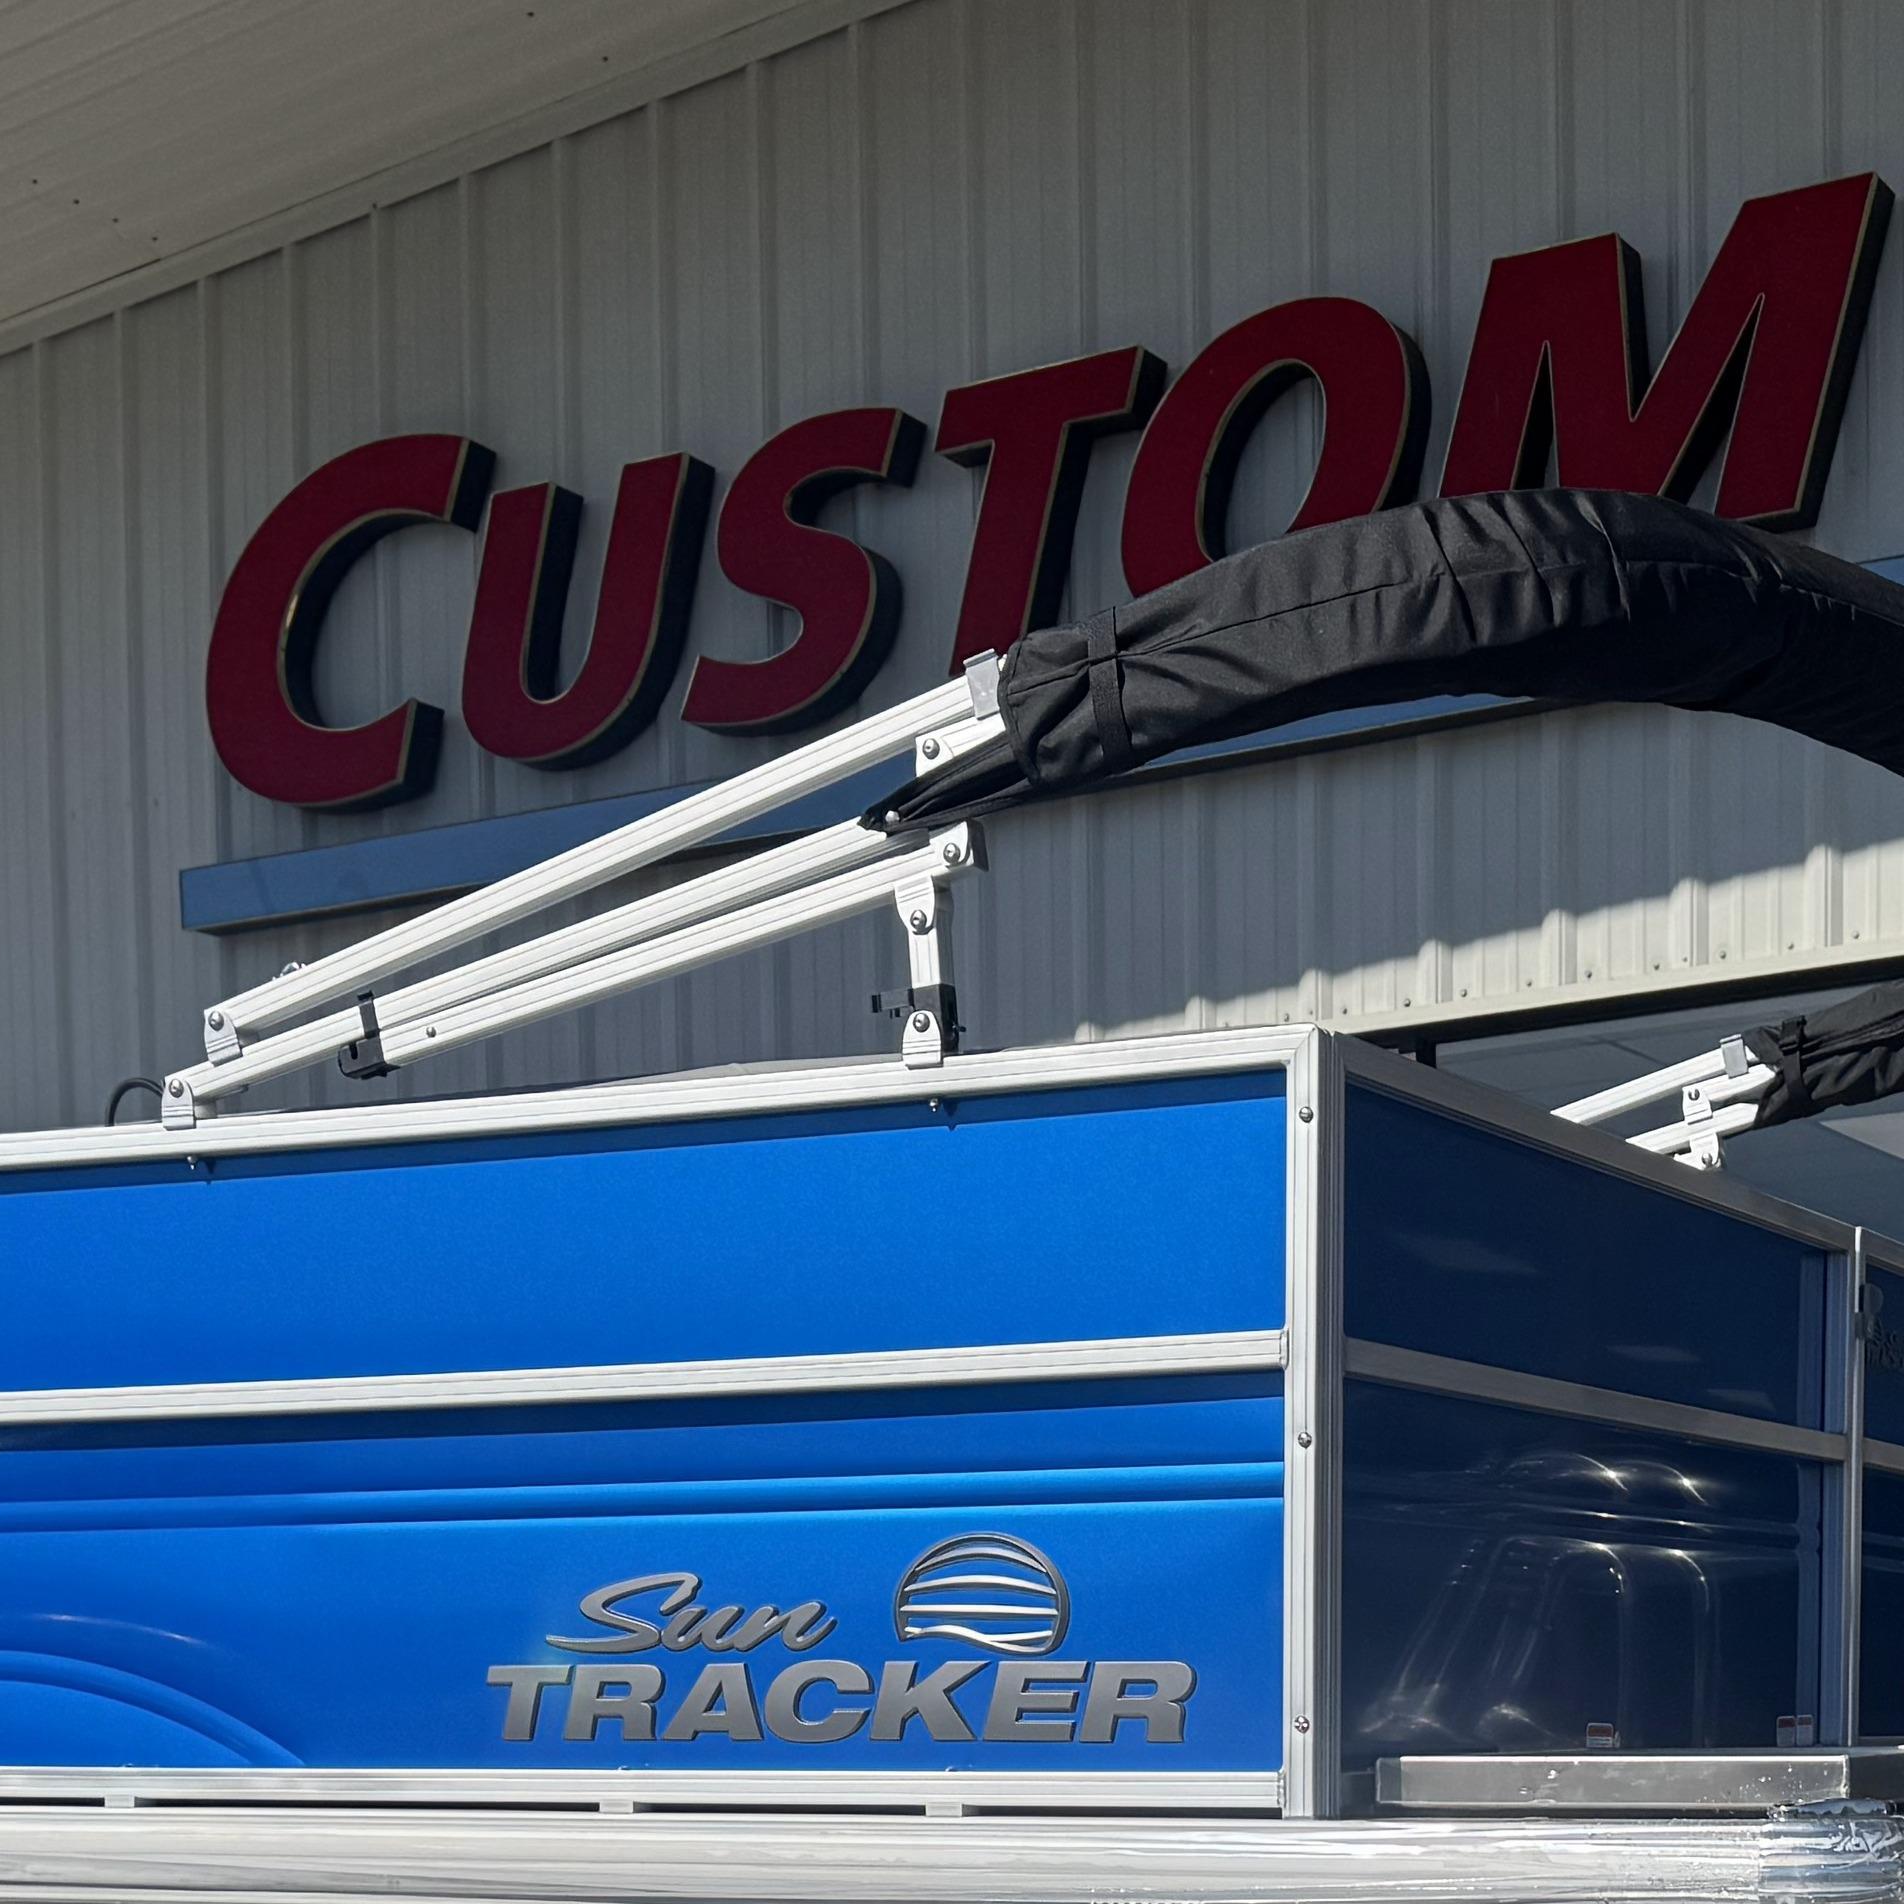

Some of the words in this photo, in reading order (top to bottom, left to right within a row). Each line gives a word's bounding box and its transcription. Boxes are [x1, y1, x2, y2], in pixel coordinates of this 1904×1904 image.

[202, 169, 1896, 812] CUSTOM
[545, 1571, 838, 1656] Sun
[486, 1658, 1198, 1744] TRACKER
